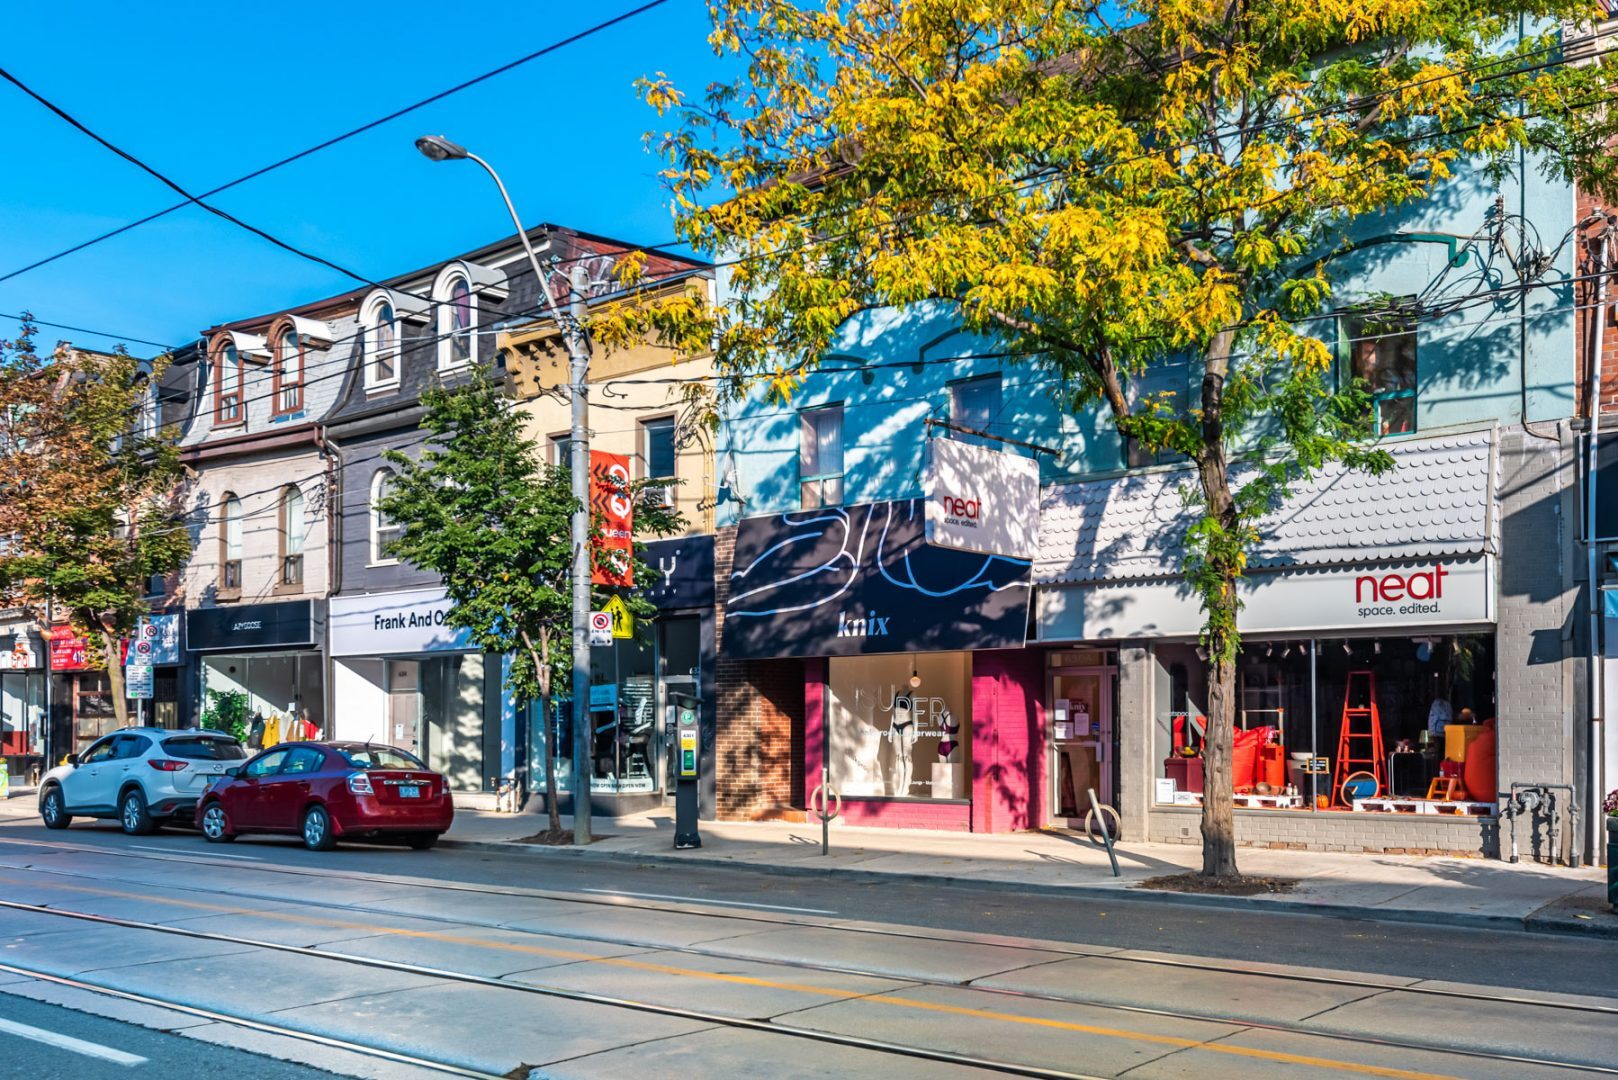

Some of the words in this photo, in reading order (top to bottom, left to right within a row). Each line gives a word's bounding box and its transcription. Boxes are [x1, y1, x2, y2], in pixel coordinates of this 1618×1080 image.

[943, 495, 982, 520] neat
[1356, 563, 1449, 603] neat
[374, 612, 406, 630] Frank
[408, 610, 432, 627] And
[1358, 606, 1396, 619] space.
[1399, 602, 1441, 614] edited.
[837, 610, 890, 638] knix
